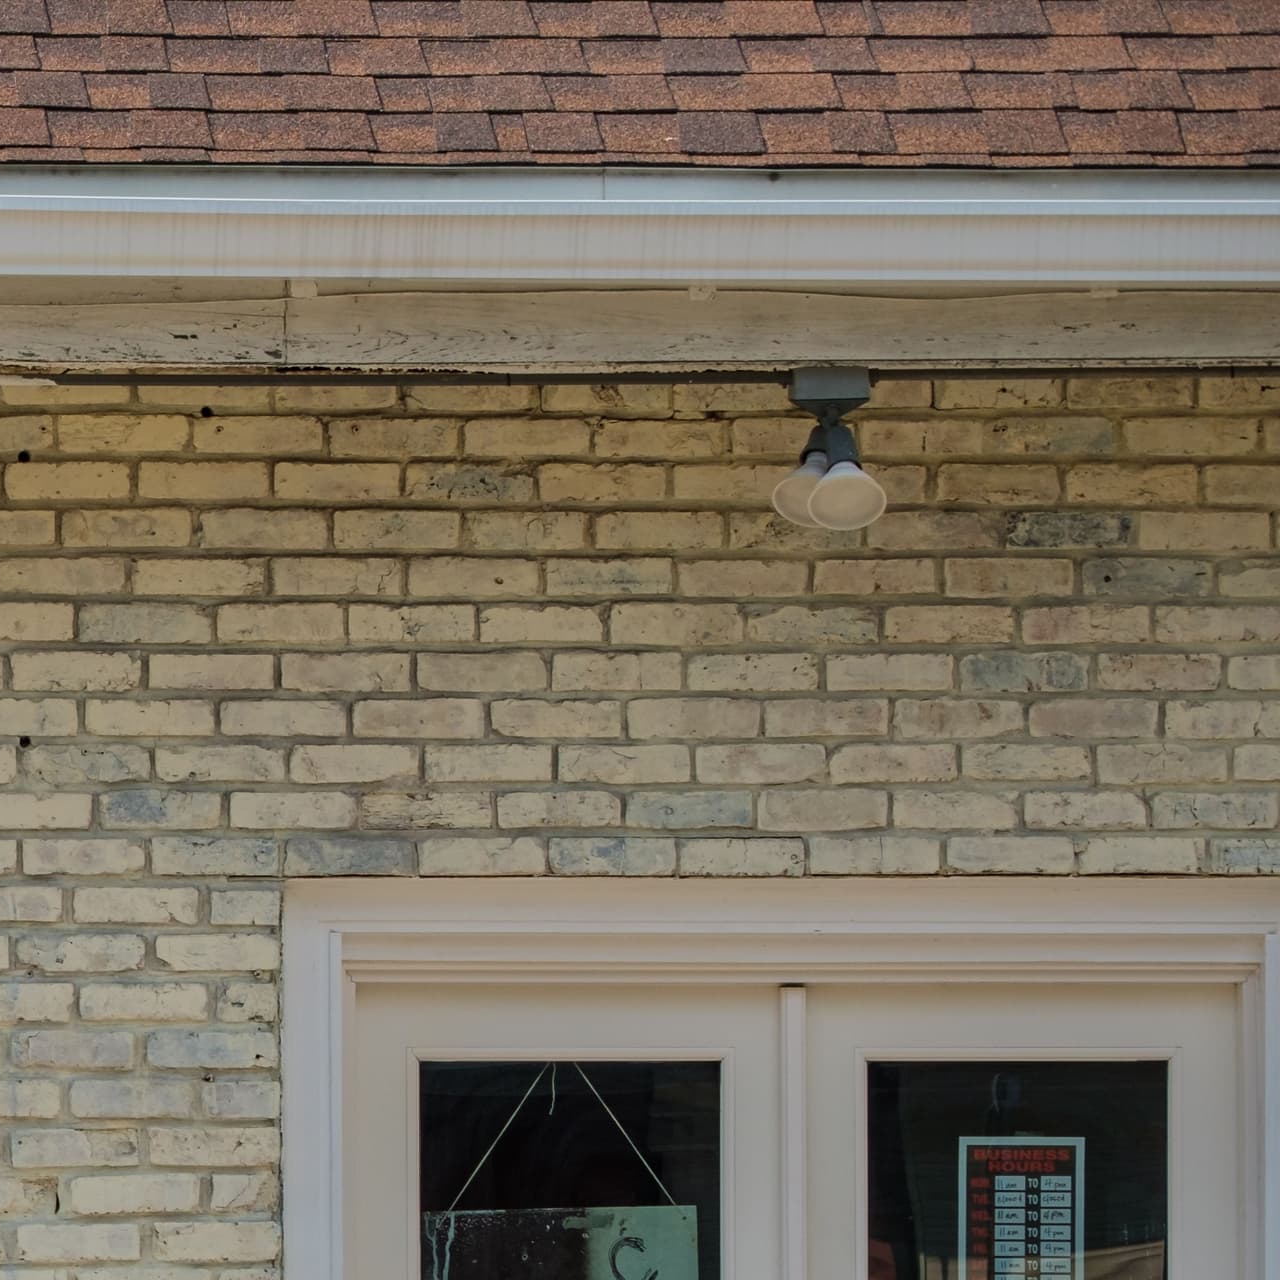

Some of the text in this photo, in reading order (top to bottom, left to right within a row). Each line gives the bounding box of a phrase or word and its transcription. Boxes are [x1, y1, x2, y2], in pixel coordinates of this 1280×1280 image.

[973, 1149, 1070, 1160] BUSINESS
[988, 1161, 1056, 1172] HOURS
[1027, 1178, 1039, 1188] TO
[1027, 1195, 1039, 1205] TO
[1027, 1211, 1039, 1221] TO
[1027, 1228, 1039, 1238] TO
[1027, 1244, 1039, 1254] TO
[1027, 1261, 1039, 1270] TO
